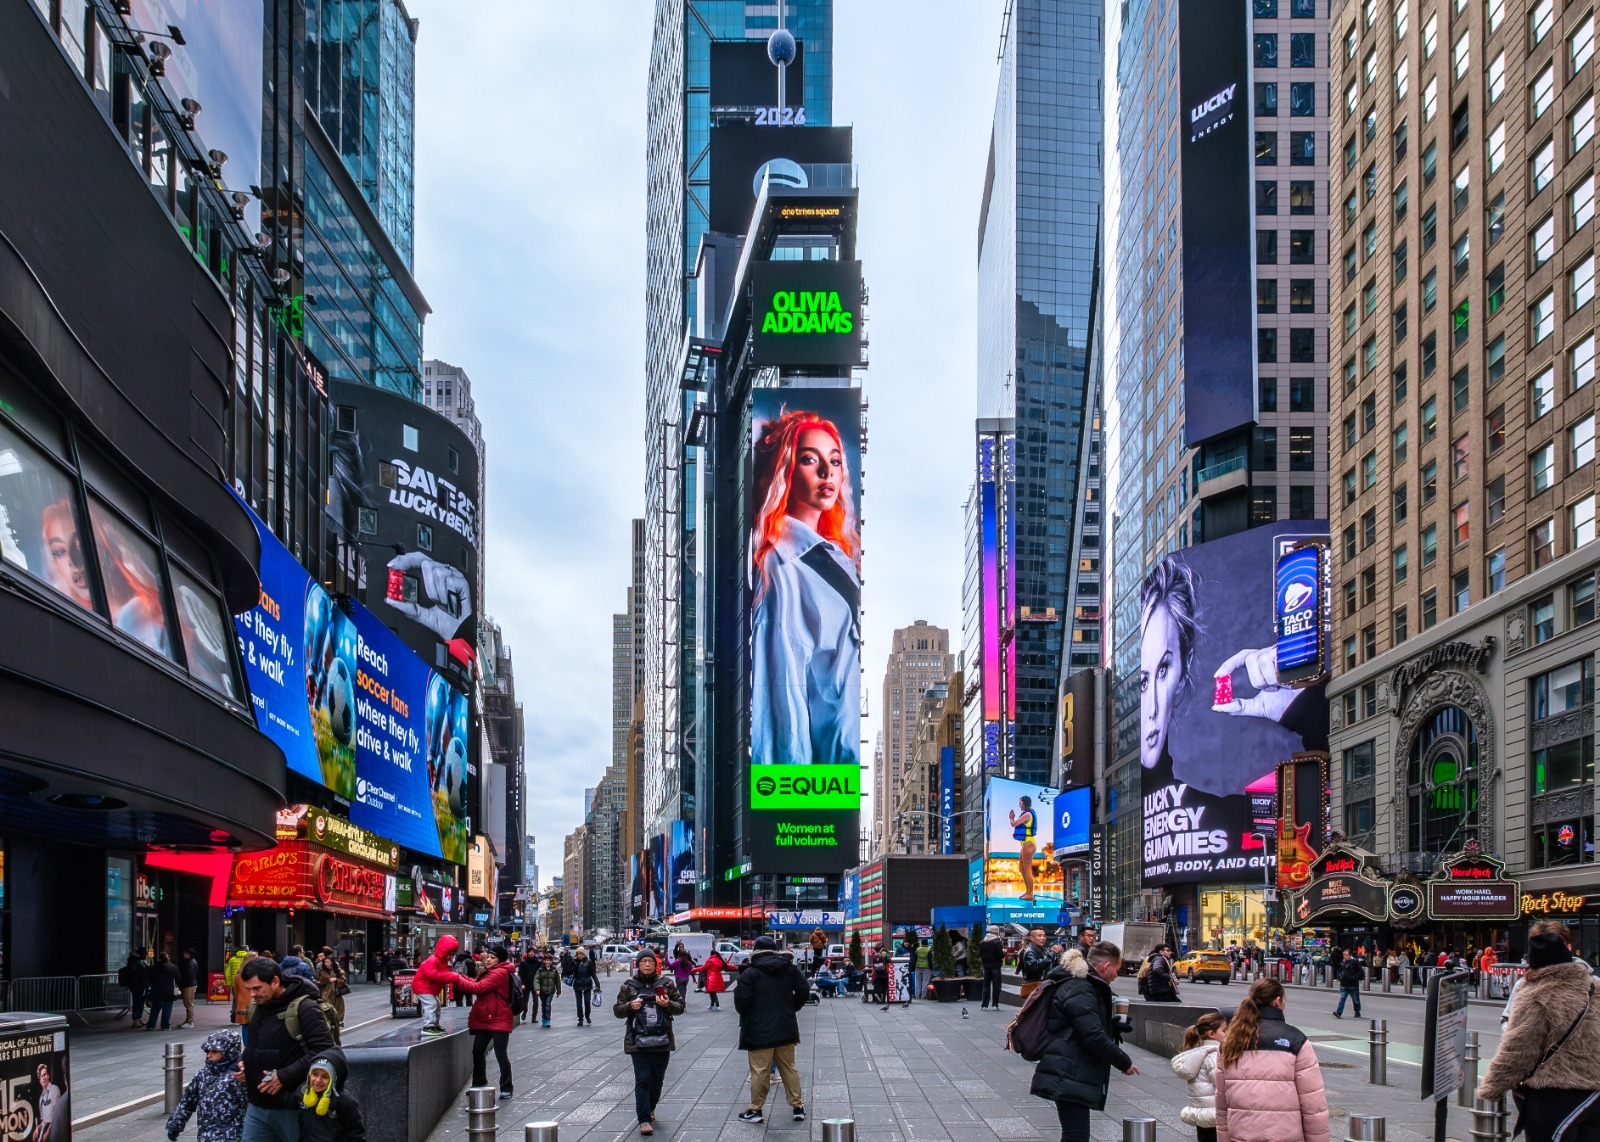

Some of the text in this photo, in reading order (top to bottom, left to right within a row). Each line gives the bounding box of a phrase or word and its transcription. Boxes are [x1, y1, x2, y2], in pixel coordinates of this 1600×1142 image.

[1191, 83, 1237, 123] LUCKY
[755, 107, 806, 126] 2026
[1191, 113, 1233, 143] ENERGY
[782, 208, 795, 216] one
[815, 208, 840, 218] square
[773, 291, 842, 312] OLIVIA
[762, 312, 853, 333] ADDAMS
[391, 459, 457, 509] SAVE
[1282, 609, 1313, 627] TACO
[1284, 620, 1313, 637] BELL
[255, 611, 279, 655] they
[248, 641, 257, 666] &
[259, 653, 285, 687] walk
[357, 635, 388, 677] Reach
[1391, 635, 1497, 717] Paramount
[357, 669, 409, 719] soccer fans
[357, 698, 387, 731] where
[389, 715, 408, 747] they
[357, 725, 413, 773] drive & walk
[985, 723, 1000, 766] ROKU
[366, 781, 379, 796] Clear
[779, 776, 857, 796] EQUAL
[1144, 783, 1188, 818] LUCKY
[1251, 798, 1272, 806] LUCKY
[777, 823, 835, 834] Women at
[1144, 805, 1206, 840] ENERGY
[776, 835, 838, 846] full volume.
[1144, 829, 1229, 863] GUMMIES
[235, 852, 298, 882] CARLO'S
[1093, 832, 1102, 919] TIMES SQUARE
[1174, 859, 1214, 873] BODY,
[1215, 857, 1247, 870] AND
[1325, 858, 1355, 873] Hard Rock
[1451, 867, 1491, 879] Hard Rock
[235, 884, 297, 896] BAKE SHOP
[1520, 890, 1584, 915] Rock Shop
[771, 912, 792, 925] NEW
[794, 912, 819, 925] YORK
[888, 962, 896, 1001] CHICAGO
[13, 1049, 21, 1059] ON
[22, 1044, 53, 1057] BROADWAY
[18, 1037, 26, 1047] OF
[27, 1036, 39, 1045] ALL
[39, 1034, 53, 1042] TIME
